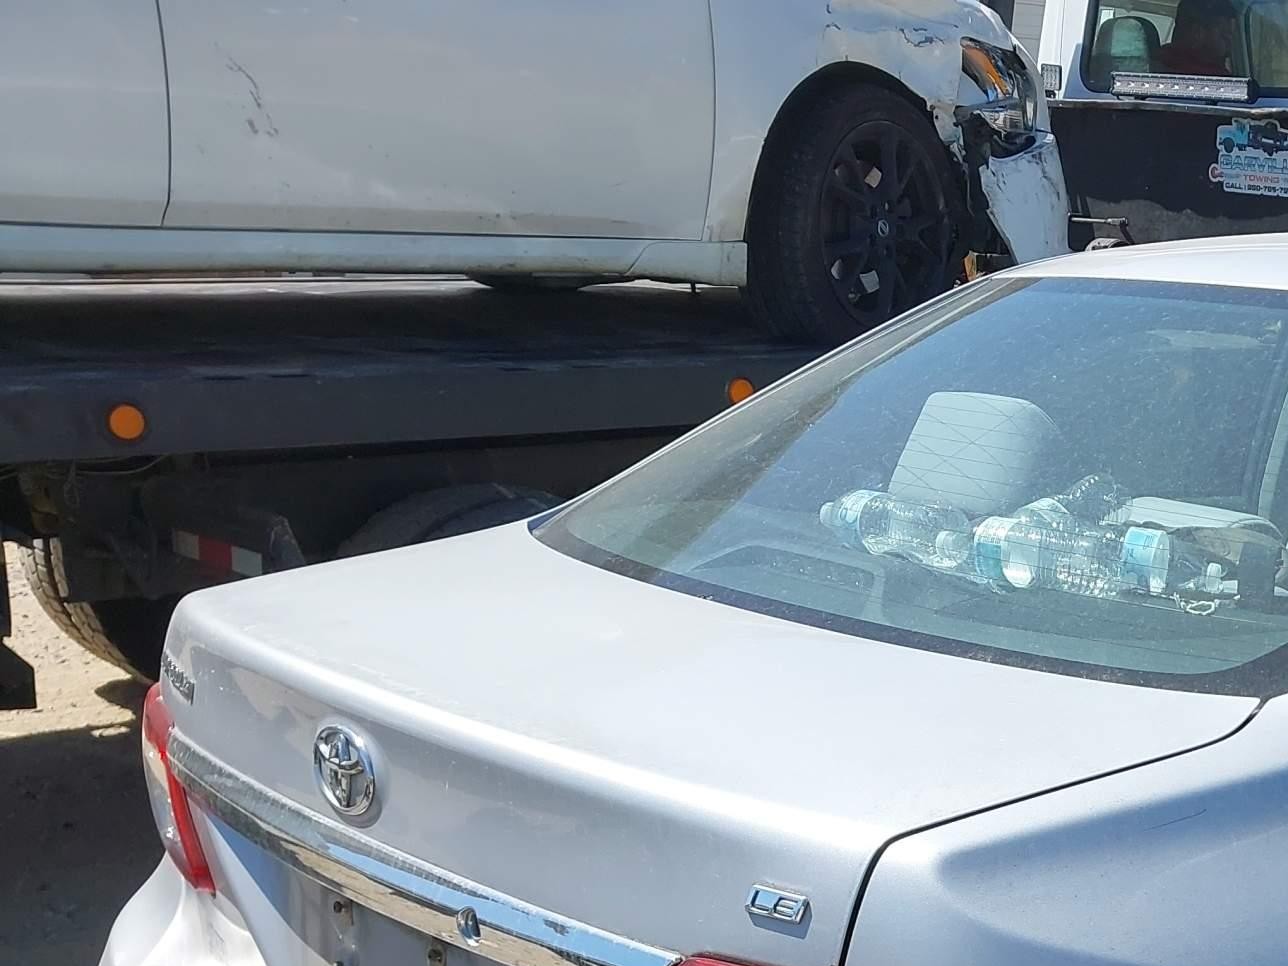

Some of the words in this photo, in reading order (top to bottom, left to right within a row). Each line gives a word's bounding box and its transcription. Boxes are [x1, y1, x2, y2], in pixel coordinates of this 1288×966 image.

[1244, 174, 1280, 184] TOWING
[1224, 182, 1243, 191] CALL
[746, 884, 809, 927] LE
